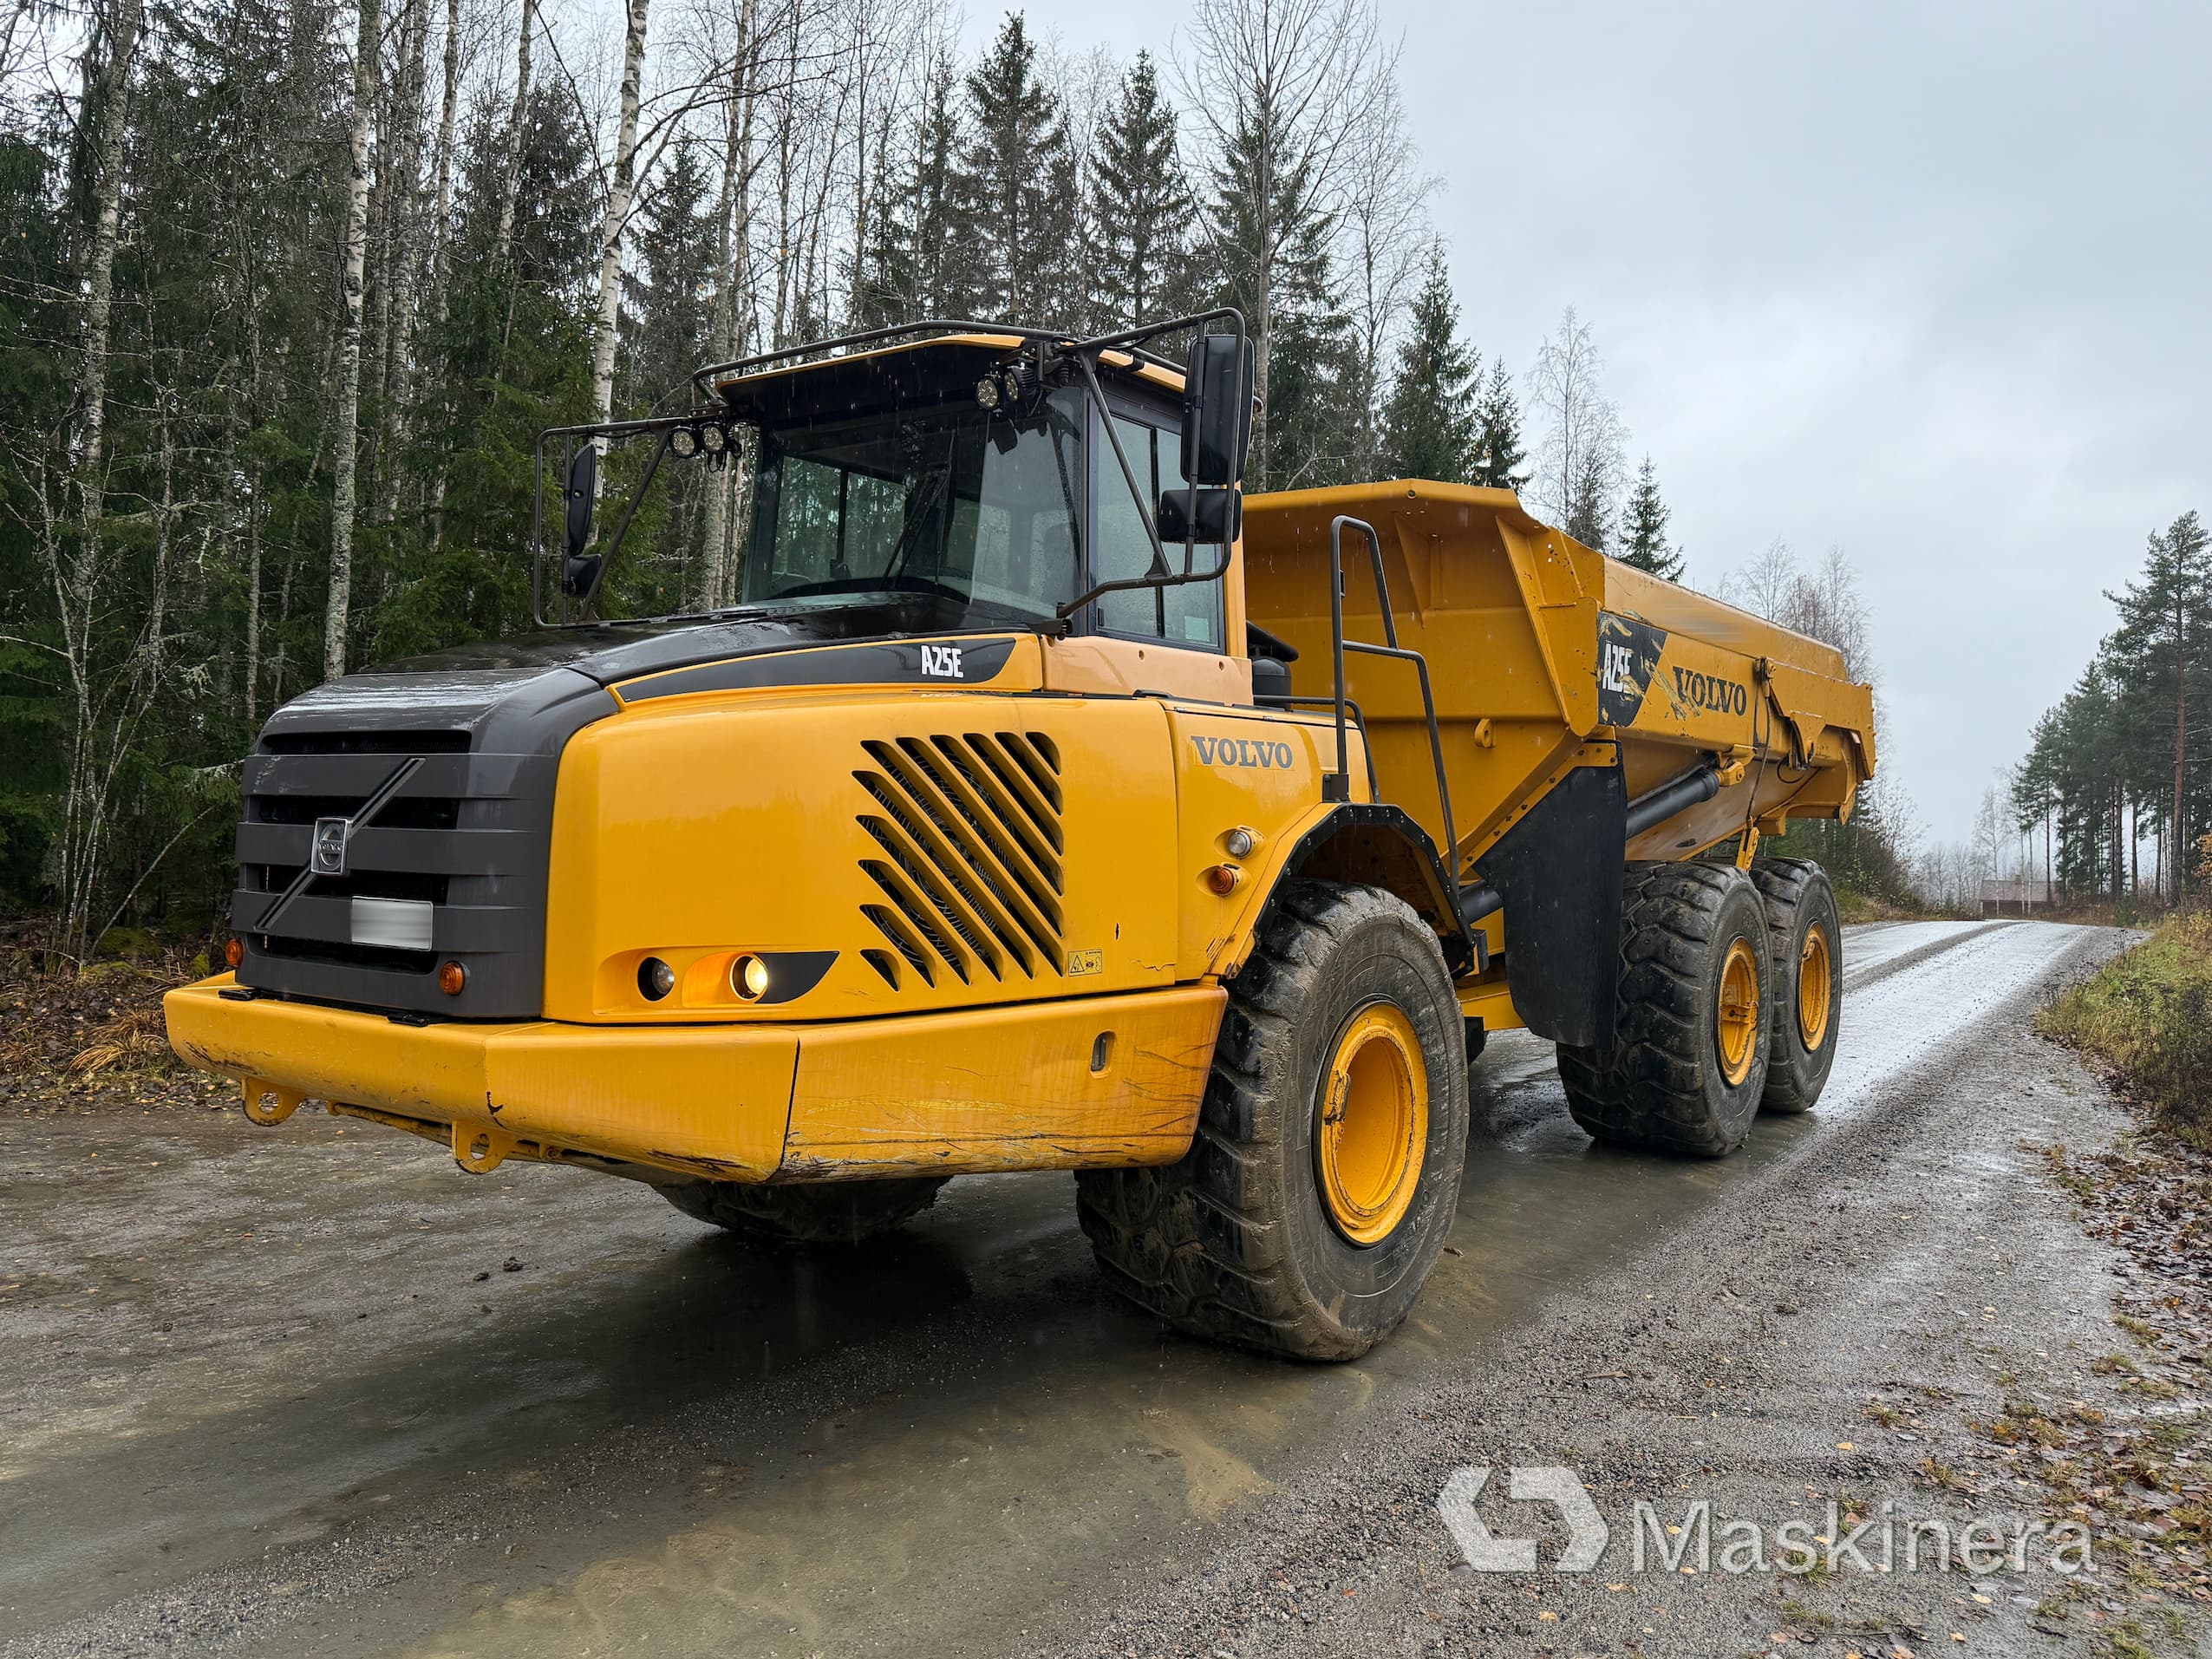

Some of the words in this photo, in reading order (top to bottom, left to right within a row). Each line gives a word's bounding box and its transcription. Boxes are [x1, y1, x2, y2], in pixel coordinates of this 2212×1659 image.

[920, 644, 964, 678] A25E
[1673, 665, 1747, 716] VOLVO
[1191, 735, 1293, 769] VOLVO
